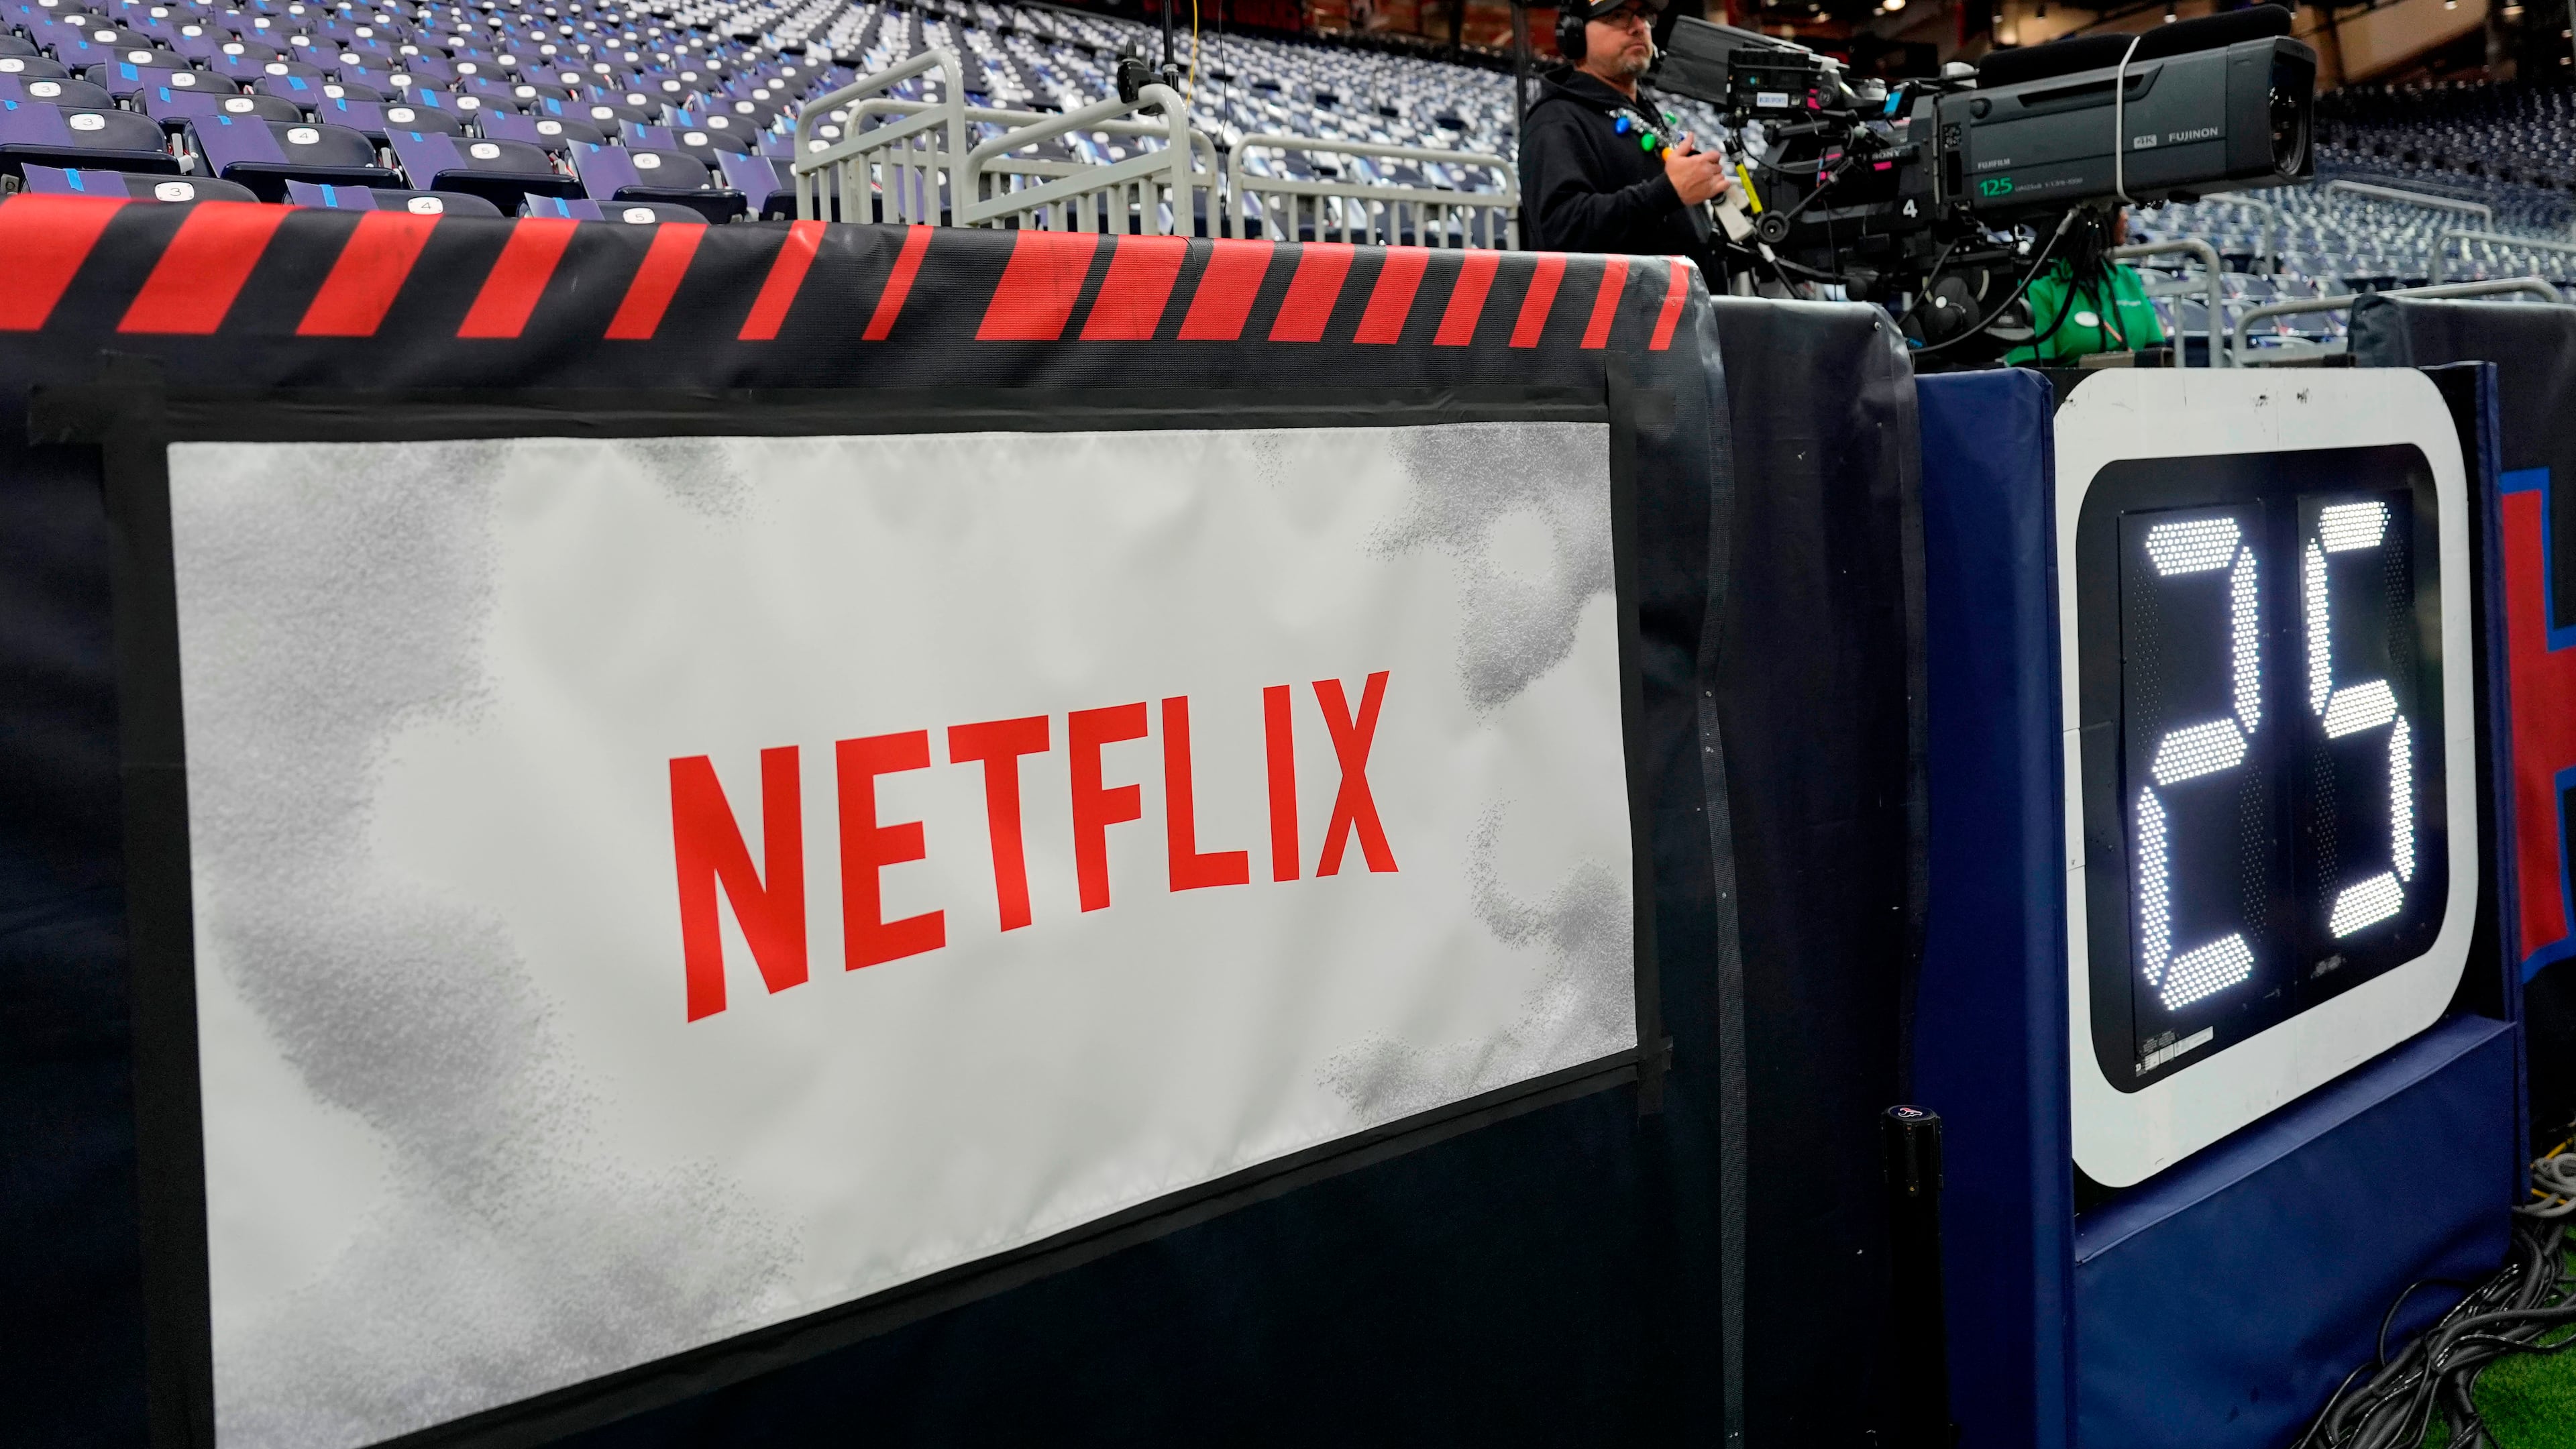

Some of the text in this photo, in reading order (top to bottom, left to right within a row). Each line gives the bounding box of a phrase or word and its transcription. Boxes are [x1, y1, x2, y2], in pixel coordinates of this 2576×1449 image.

[42, 85, 51, 93] 3
[2169, 127, 2218, 142] FUJINON
[1872, 150, 1900, 160] SONY
[1978, 158, 2010, 169] FUJIFILM
[170, 187, 182, 197] 3
[1980, 177, 2013, 197] 125
[421, 202, 431, 210] 4
[1902, 199, 1918, 218] 4
[635, 213, 645, 221] 5
[2138, 502, 2414, 1010] 25
[670, 671, 1398, 1022] NETFLIX
